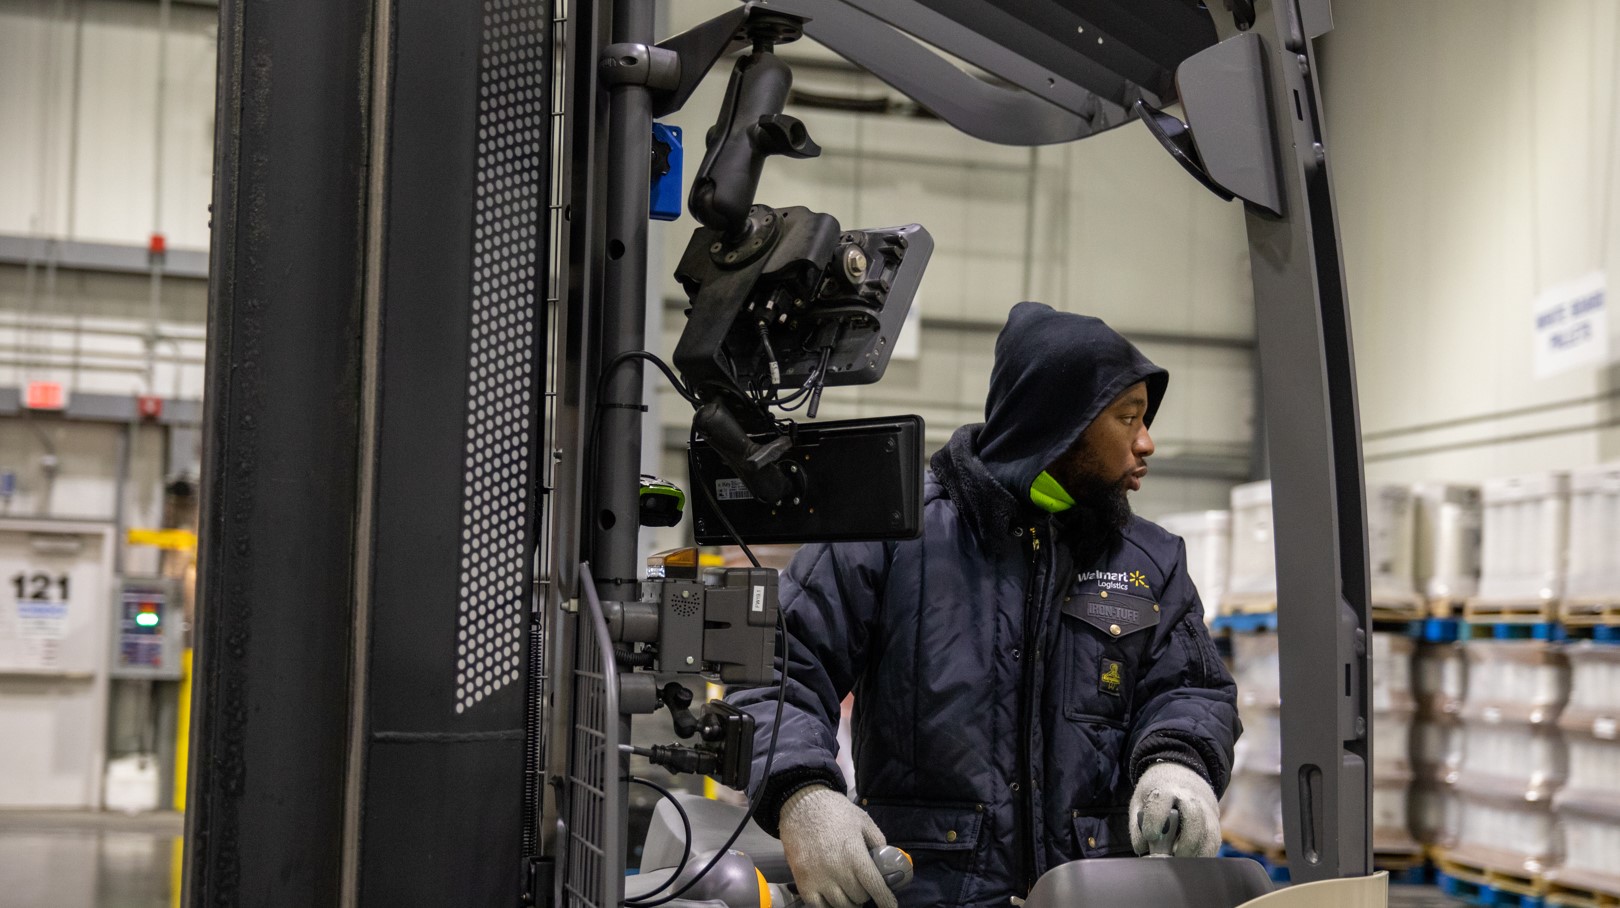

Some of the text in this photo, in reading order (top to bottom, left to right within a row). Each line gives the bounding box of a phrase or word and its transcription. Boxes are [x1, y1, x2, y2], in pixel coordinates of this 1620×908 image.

[1078, 570, 1128, 582] Walmart
[12, 574, 69, 600] 121
[1098, 580, 1128, 590] Logistics
[1088, 602, 1139, 621] IRON-TUFF
